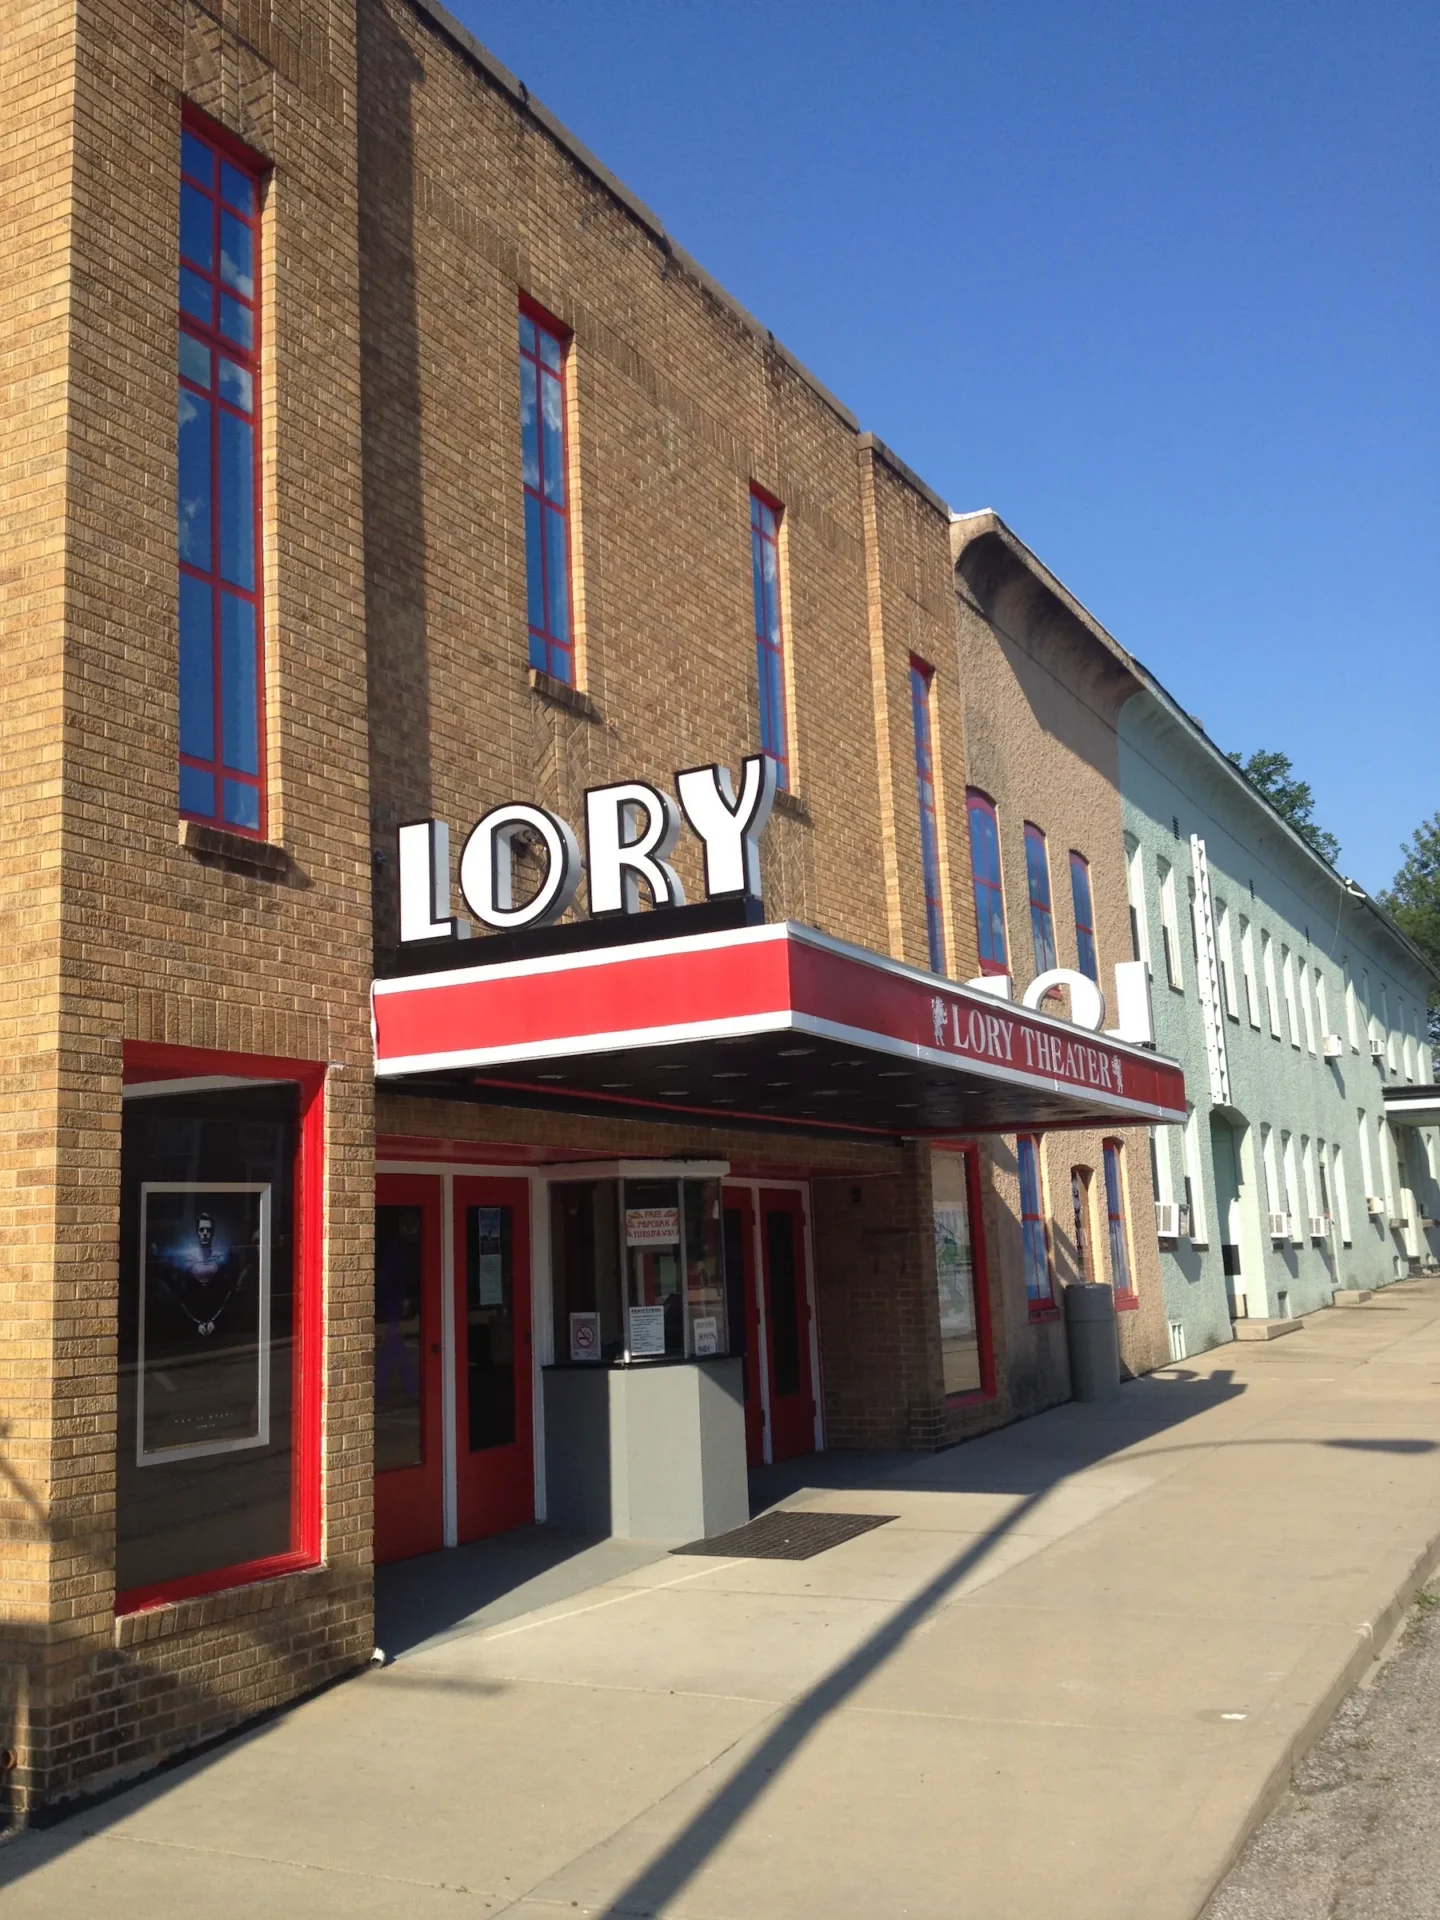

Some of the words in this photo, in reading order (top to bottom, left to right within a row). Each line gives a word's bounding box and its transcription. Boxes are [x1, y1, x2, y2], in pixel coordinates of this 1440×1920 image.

[398, 753, 775, 943] LORY
[951, 1003, 1014, 1061] LORY
[1020, 1025, 1112, 1088] THEATER
